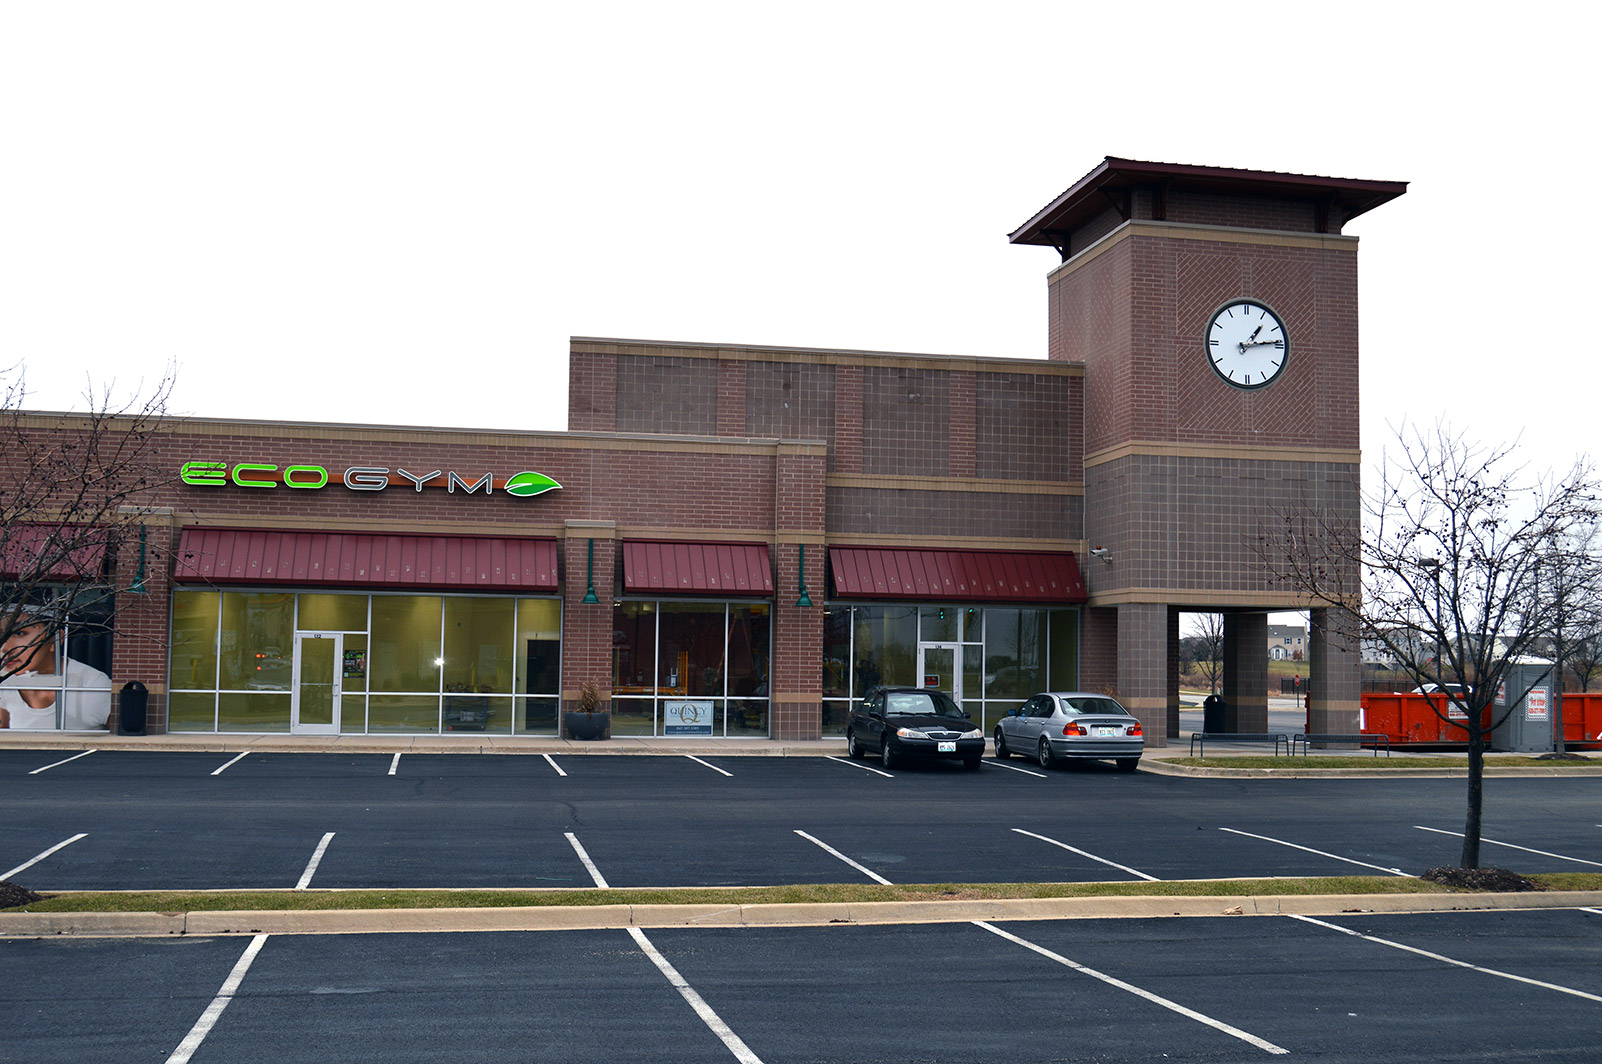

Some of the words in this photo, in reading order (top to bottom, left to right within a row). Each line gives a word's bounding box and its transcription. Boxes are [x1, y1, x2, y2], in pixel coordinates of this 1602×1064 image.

[181, 461, 328, 489] ECO
[343, 466, 493, 495] GYM
[670, 707, 707, 715] QUINCY
